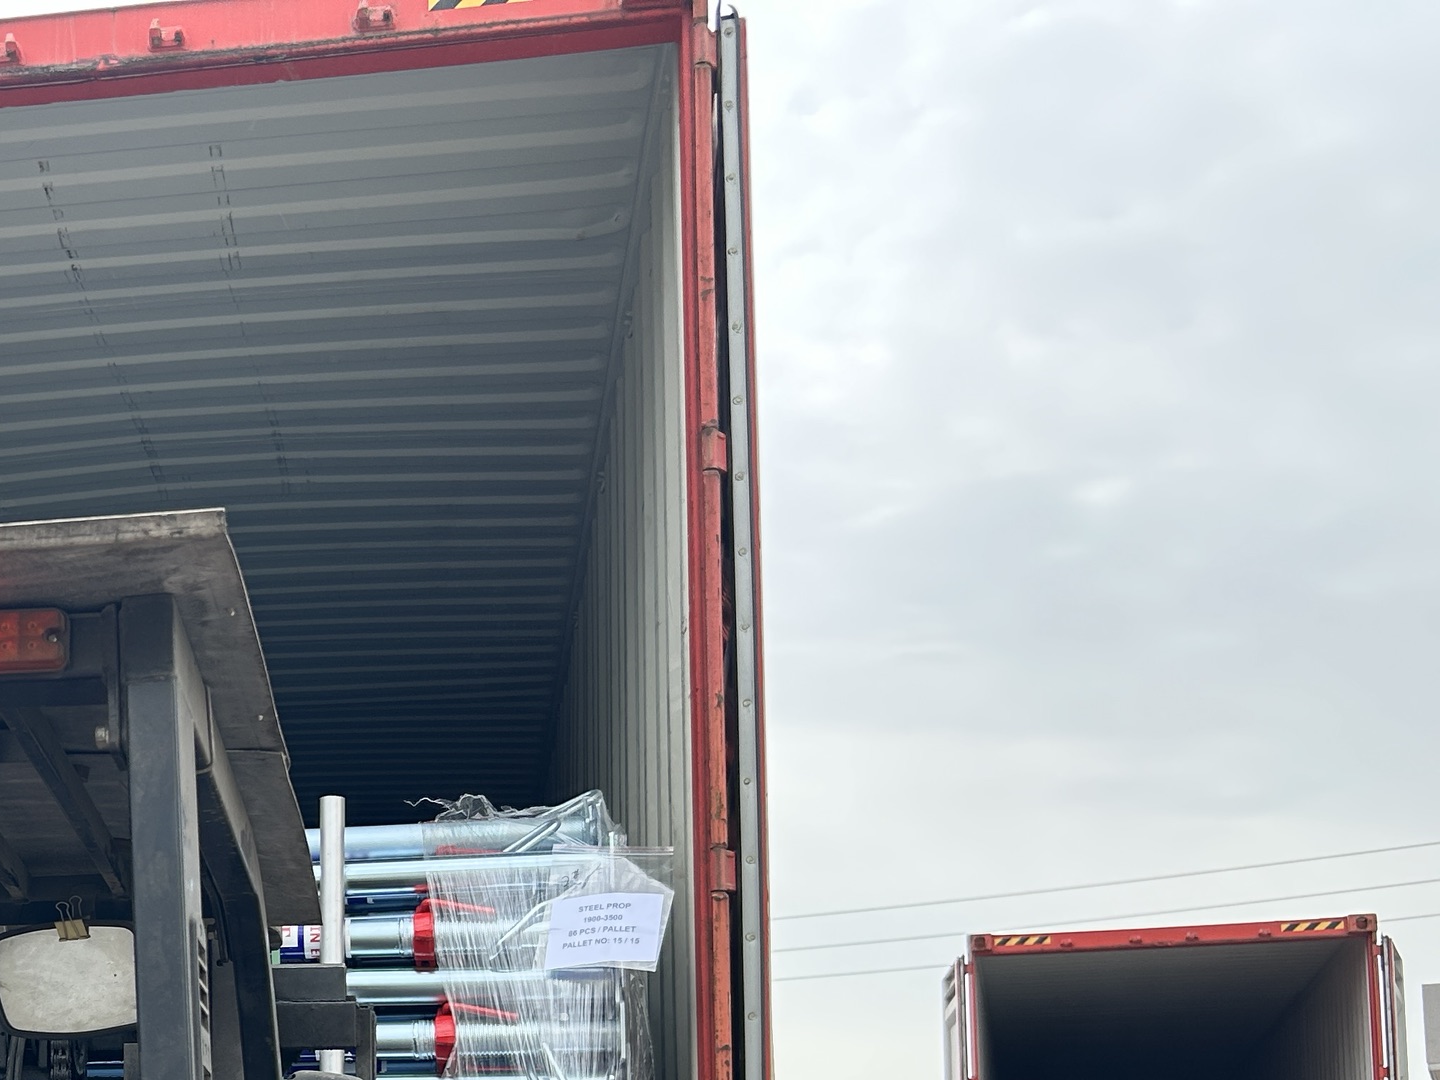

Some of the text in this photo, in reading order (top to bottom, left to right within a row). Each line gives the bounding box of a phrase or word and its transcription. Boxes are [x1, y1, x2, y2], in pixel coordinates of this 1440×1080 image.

[578, 902, 632, 912] STEEL PROP
[583, 914, 623, 923] 1900-3500
[579, 927, 596, 936] PCS
[602, 925, 637, 933] PALLET
[562, 939, 593, 949] PALLET
[594, 937, 610, 945] NO:
